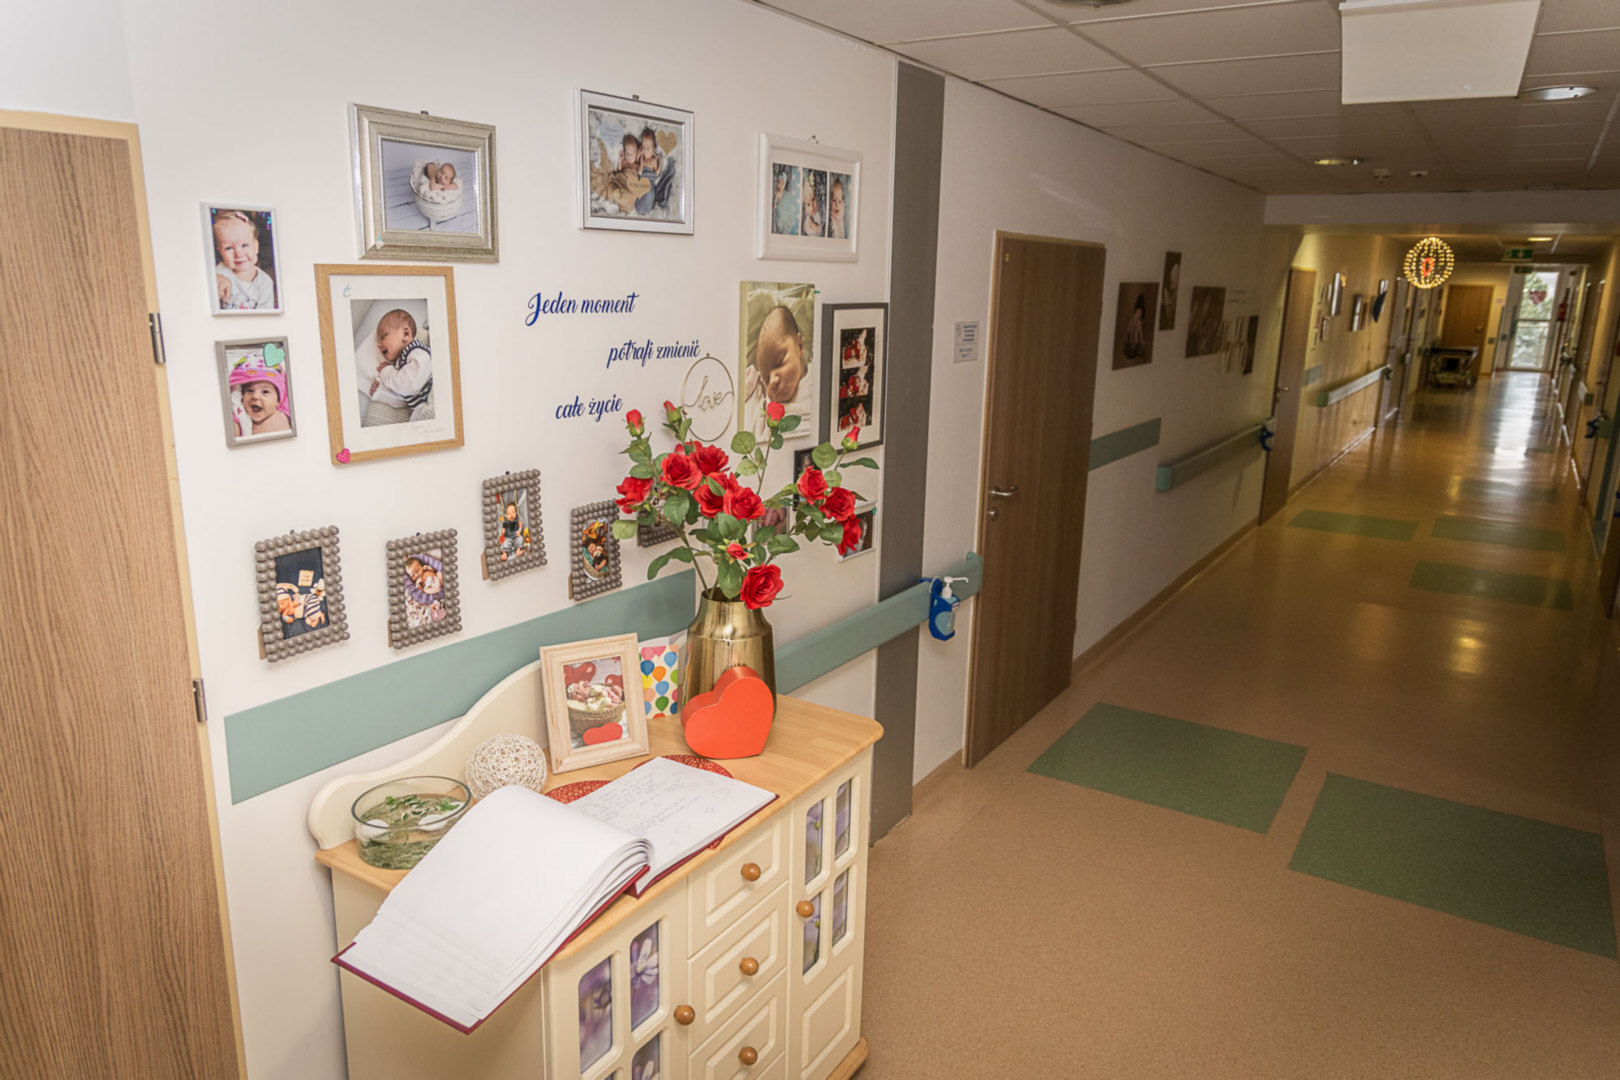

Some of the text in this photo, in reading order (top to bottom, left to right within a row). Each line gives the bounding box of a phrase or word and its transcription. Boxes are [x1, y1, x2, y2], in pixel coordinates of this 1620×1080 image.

[525, 290, 639, 327] Jeden moment
[606, 339, 700, 369] potrafi zmienić
[555, 394, 623, 422] całe życie
